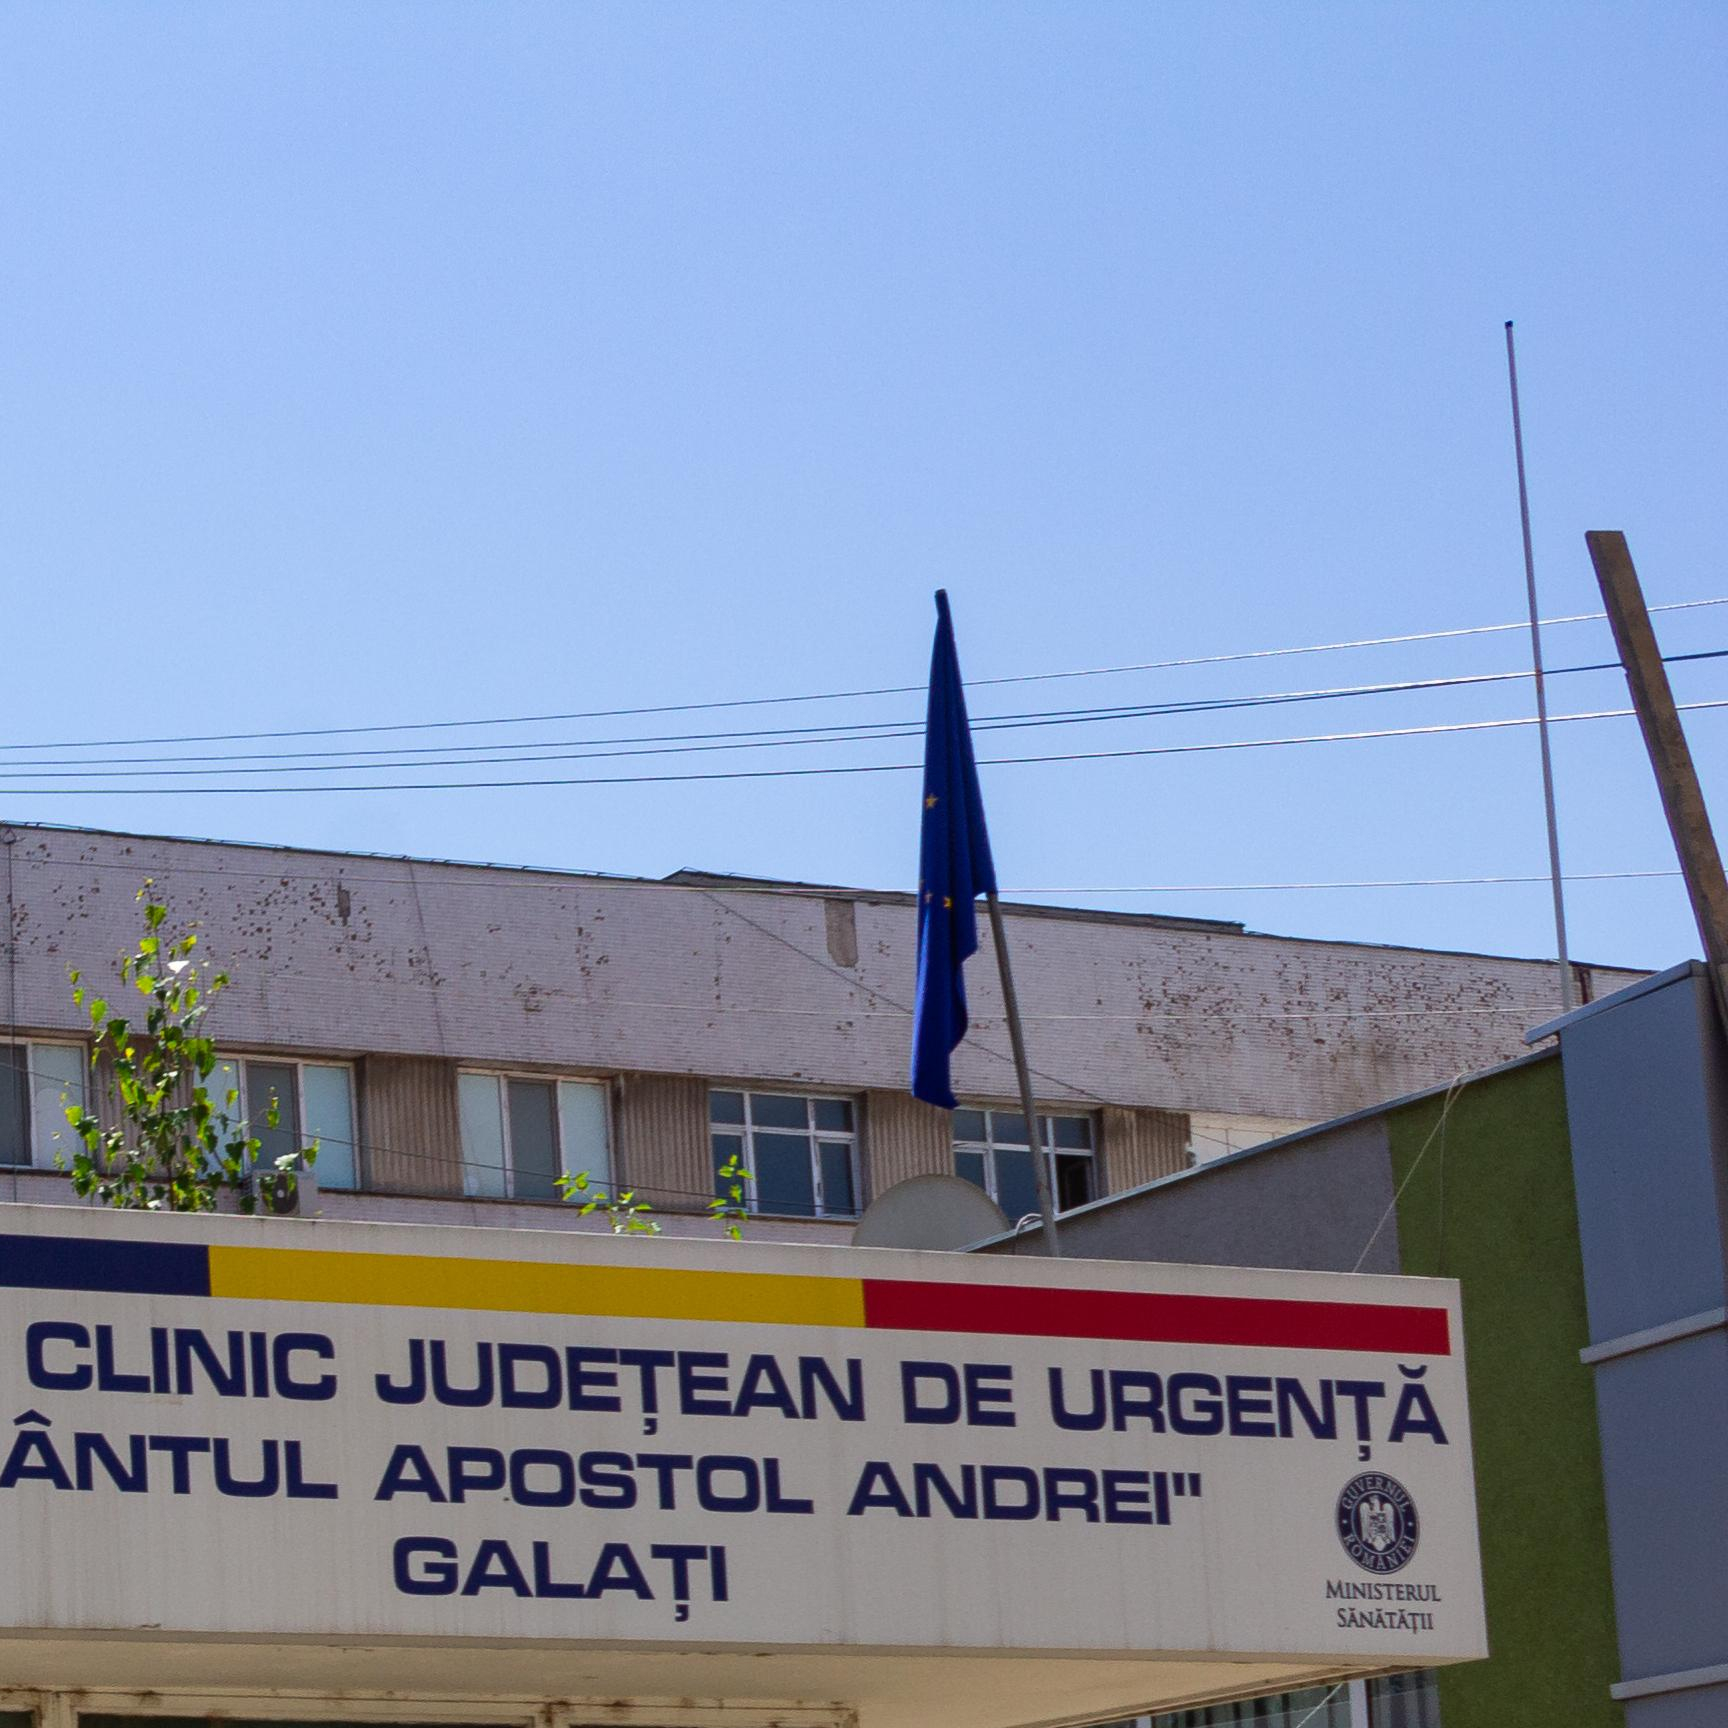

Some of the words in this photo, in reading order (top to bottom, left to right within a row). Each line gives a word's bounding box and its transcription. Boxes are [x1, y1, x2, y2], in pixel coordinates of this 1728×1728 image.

[26, 1322, 337, 1401] CLINIC
[375, 1339, 866, 1435] JUDEȚEAN
[900, 1361, 1016, 1427] DE
[1048, 1364, 1448, 1461] URGENȚĂ
[374, 1445, 814, 1514] APOSTOL
[847, 1461, 1201, 1525] ANDREI"
[1342, 1477, 1411, 1512] GUVERNUL
[393, 1537, 728, 1622] GALAȚI
[1325, 1580, 1441, 1602] MINISTERUL
